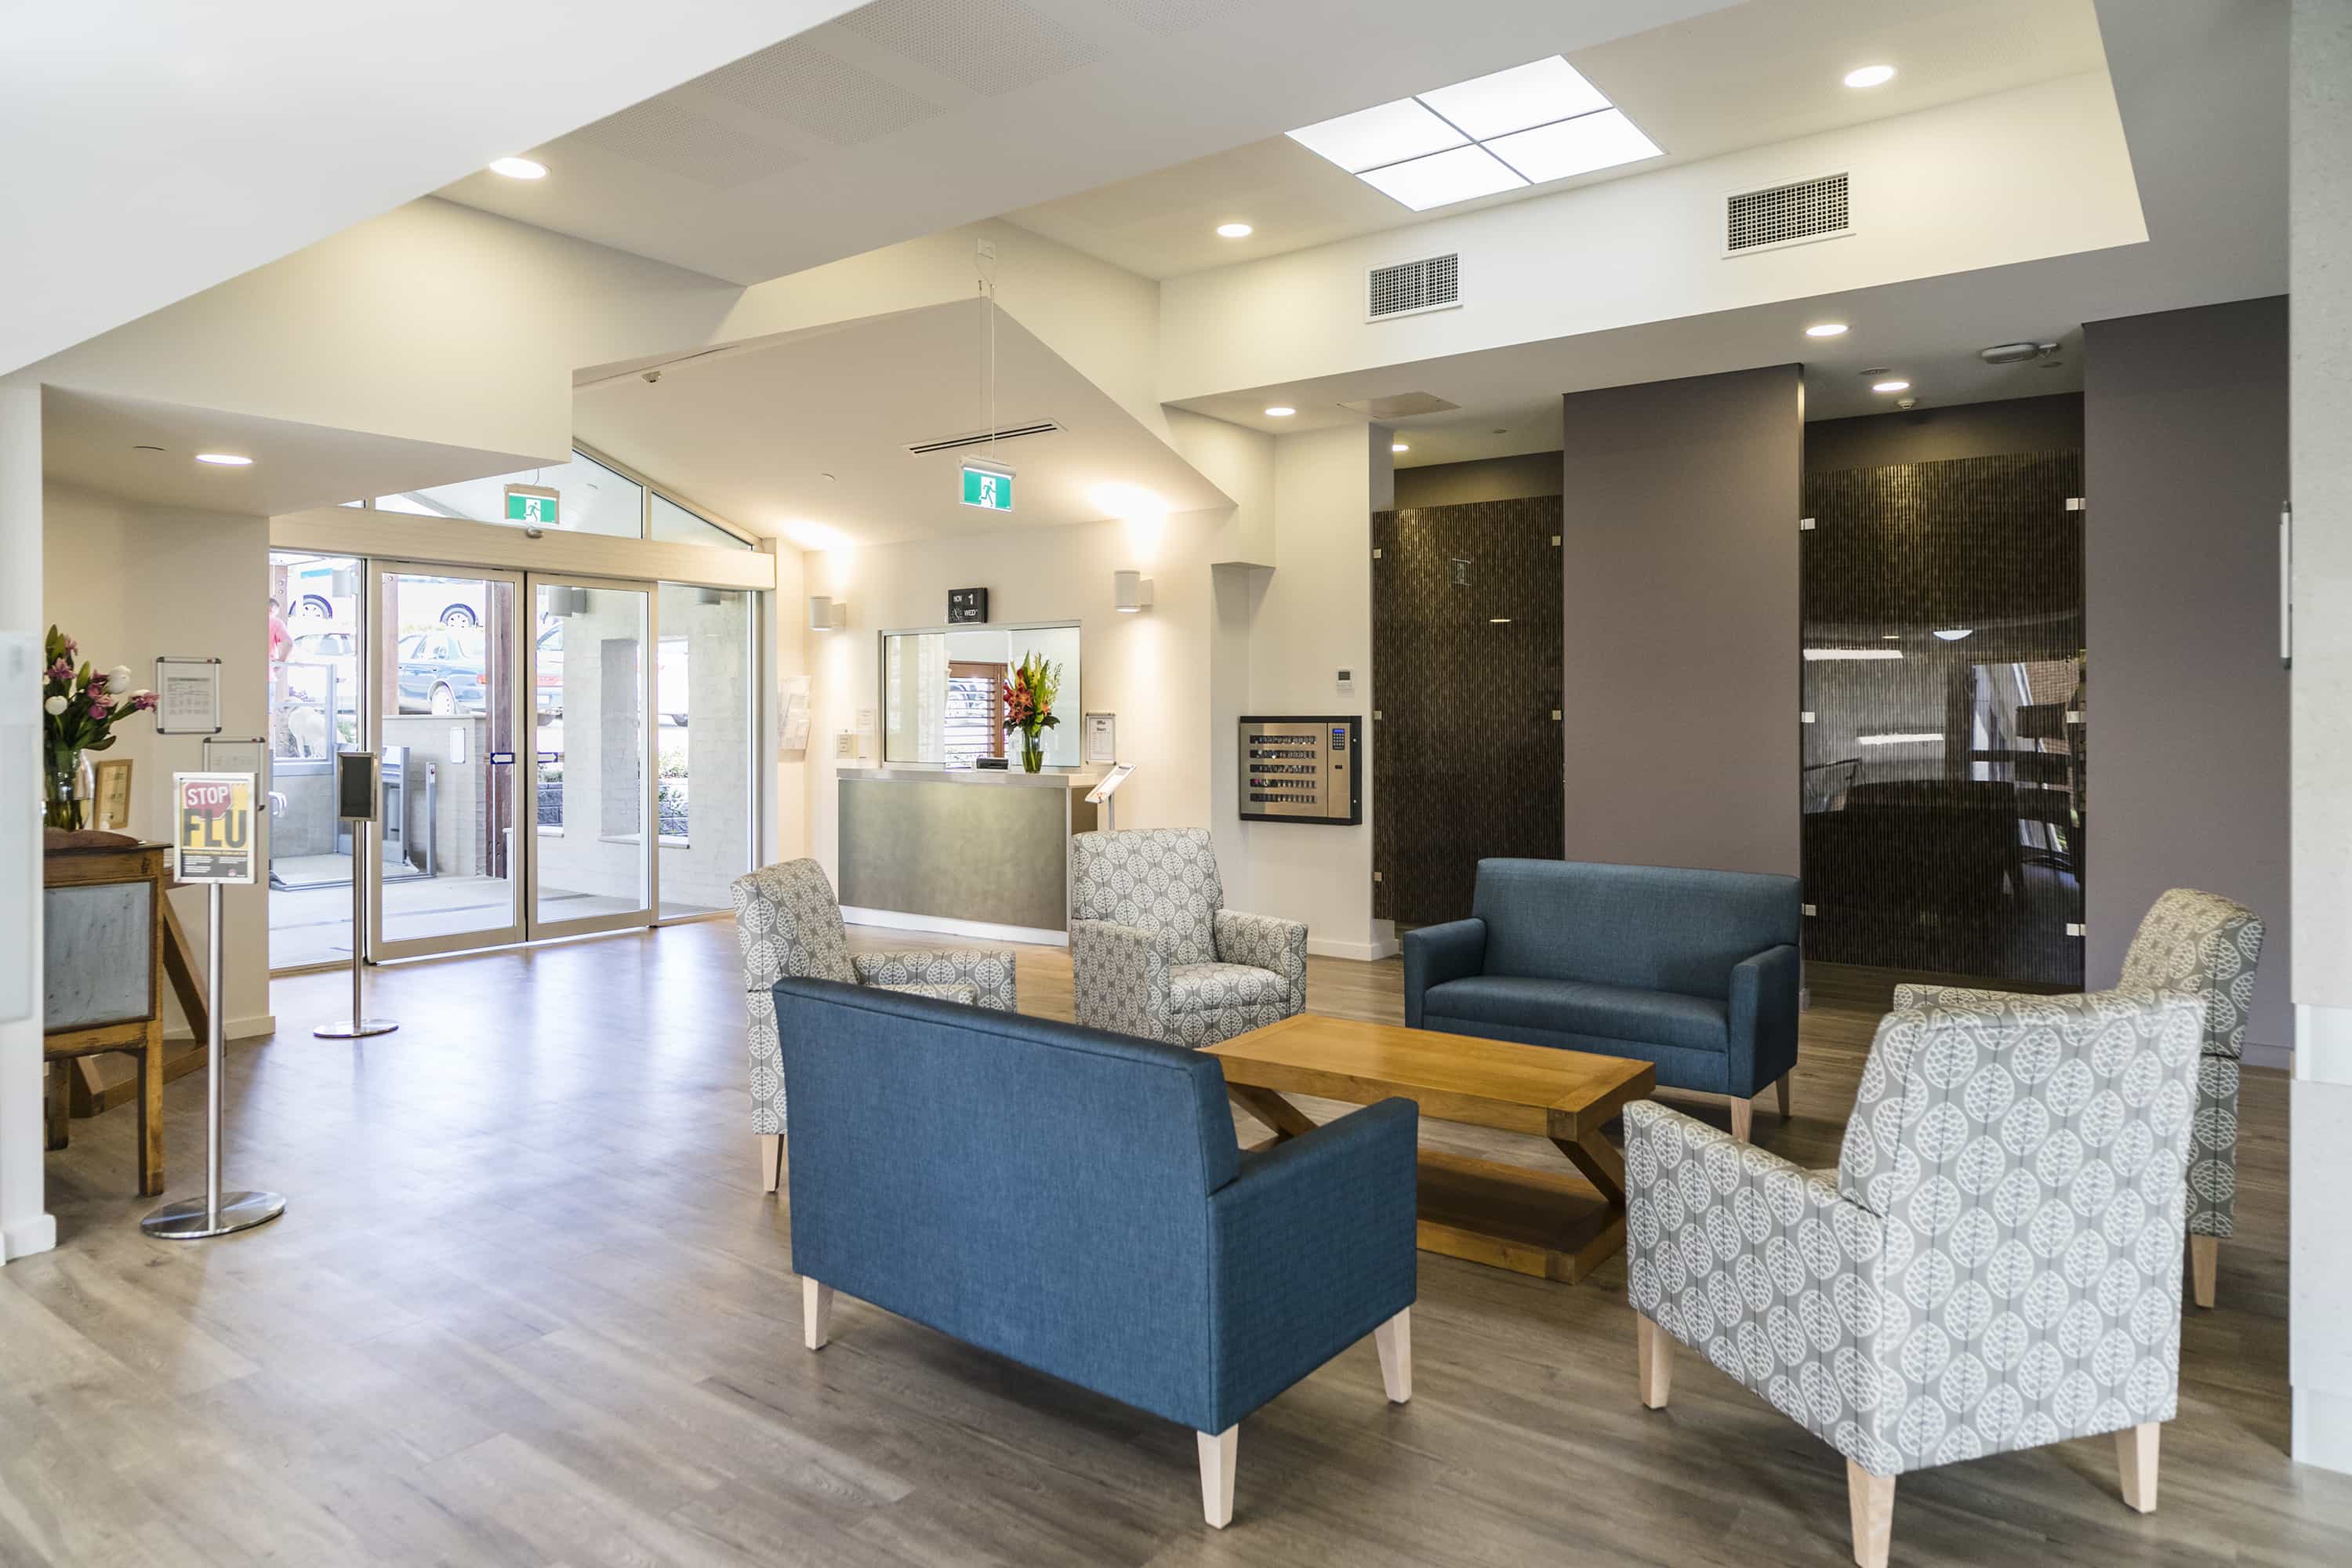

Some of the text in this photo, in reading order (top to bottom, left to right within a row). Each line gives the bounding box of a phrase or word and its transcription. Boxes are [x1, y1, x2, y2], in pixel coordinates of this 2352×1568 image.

[967, 593, 974, 605] 1
[187, 786, 228, 806] STOP
[183, 808, 247, 848] FLU
